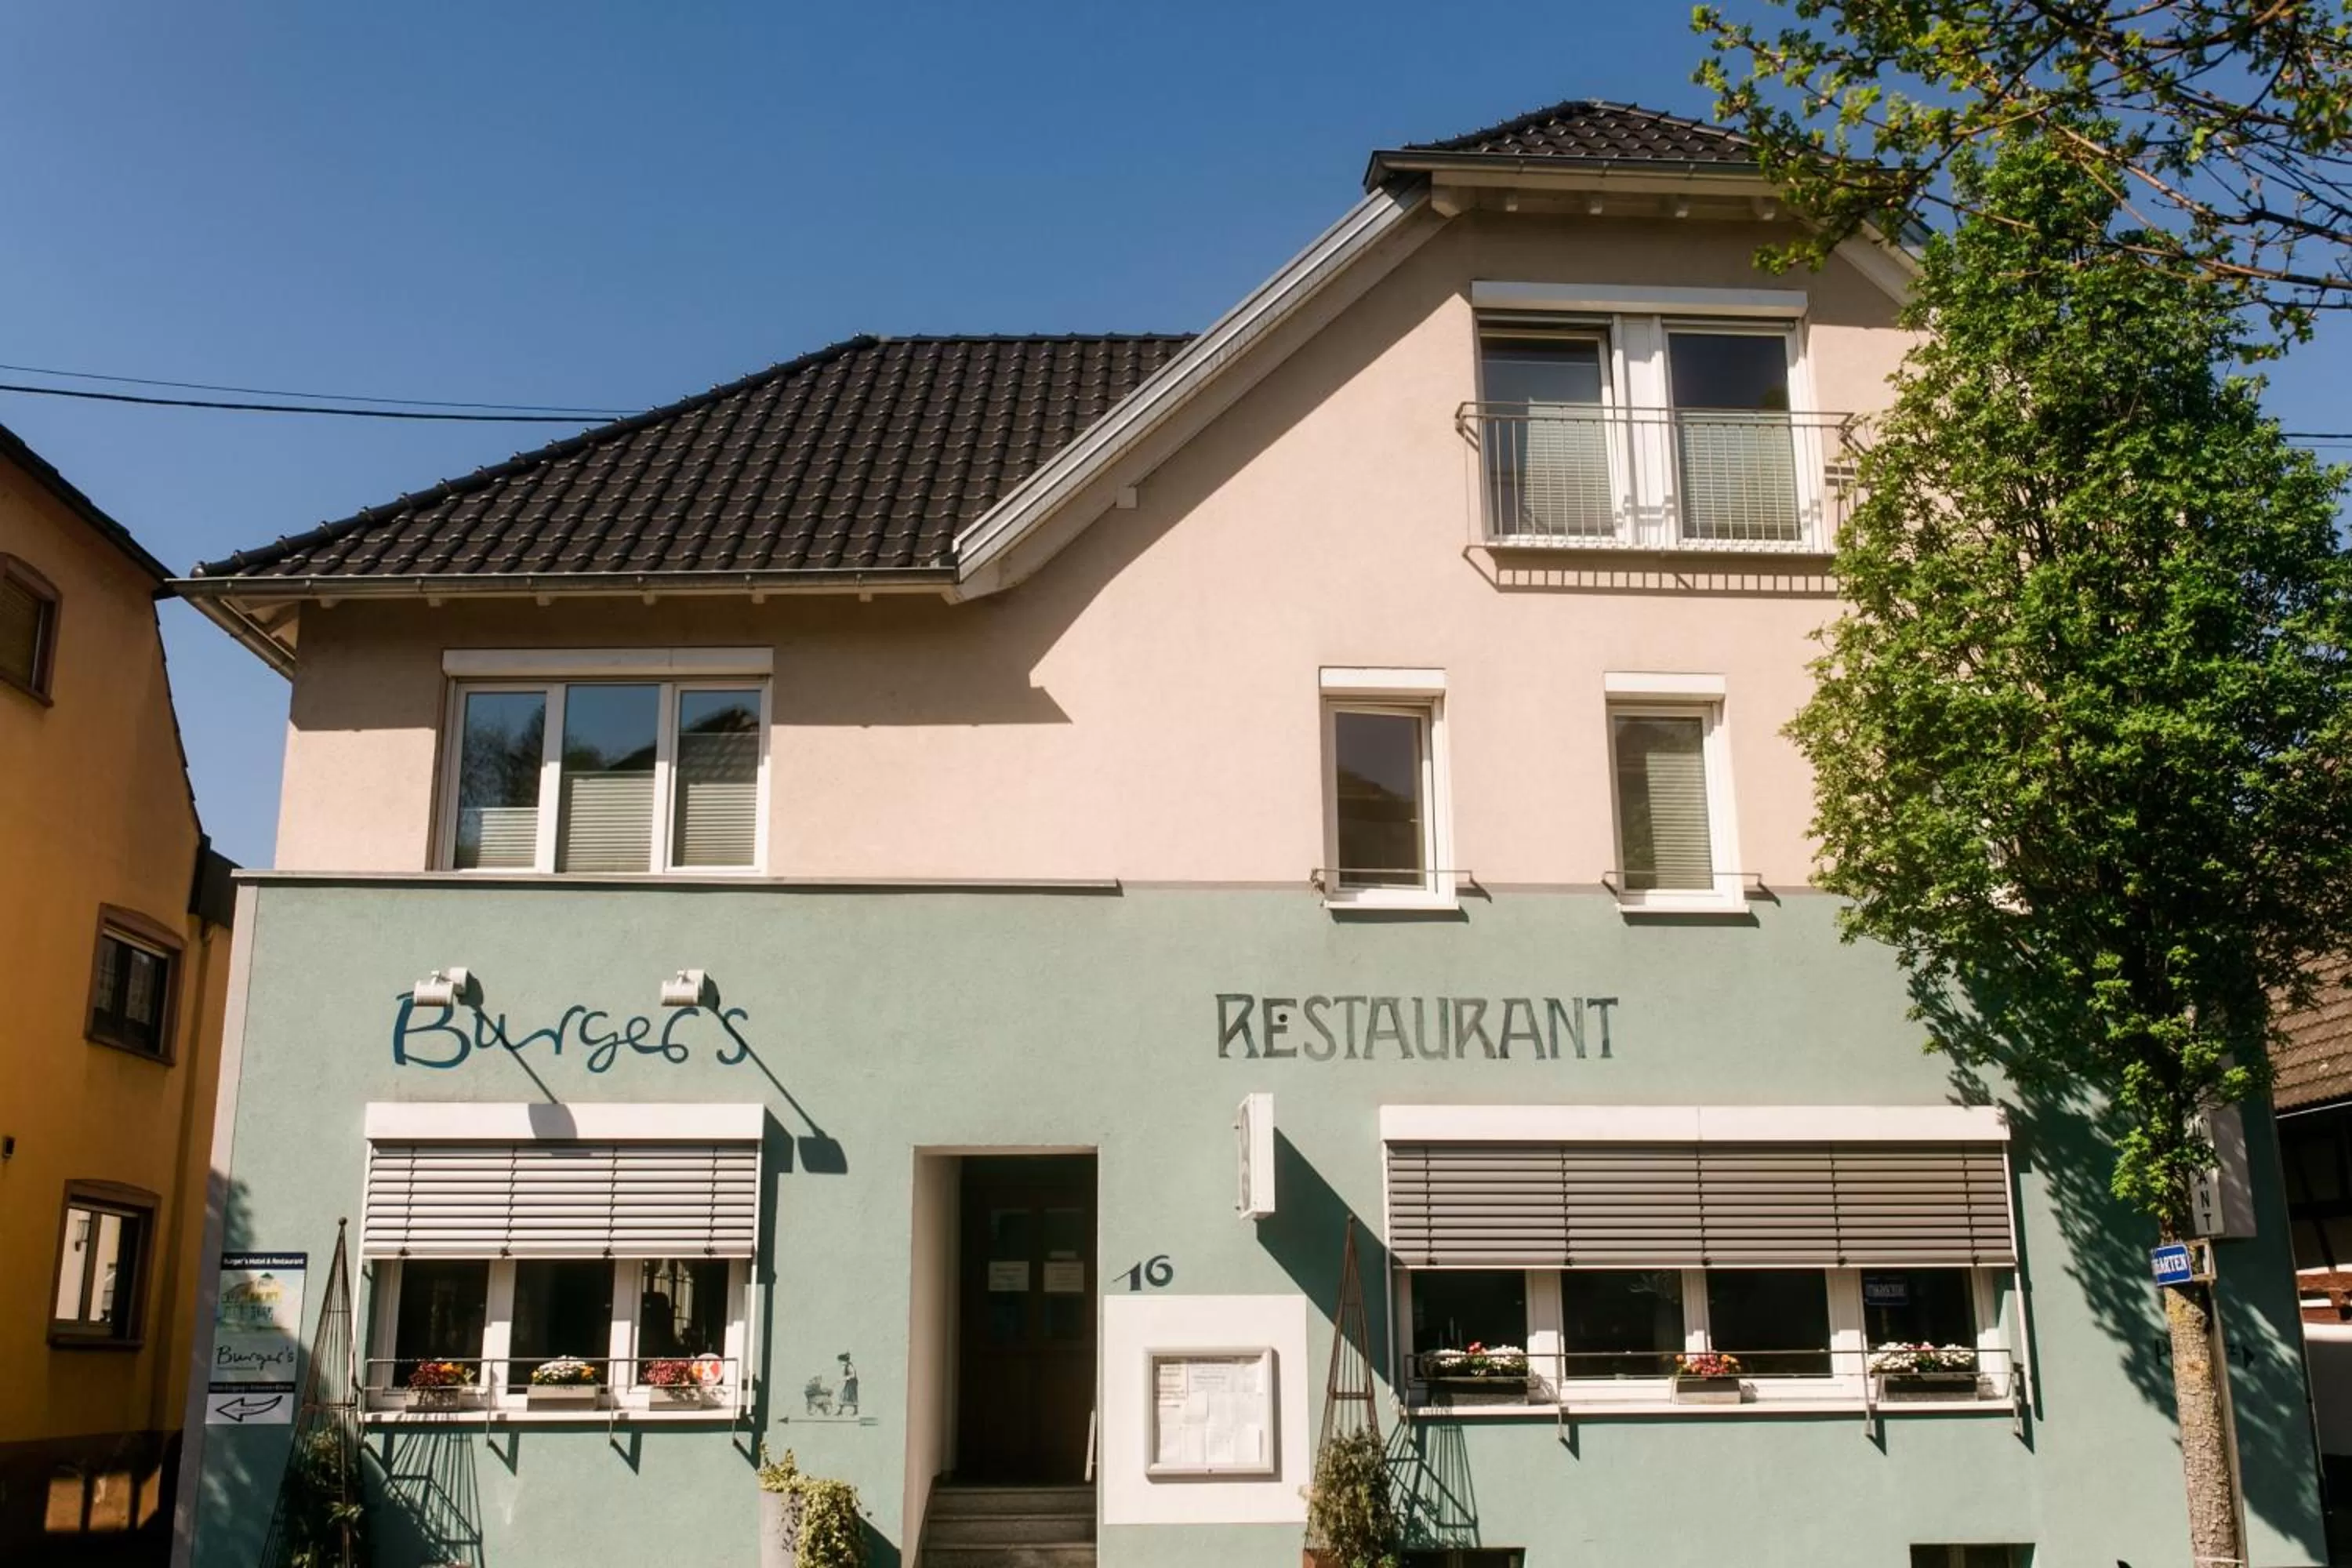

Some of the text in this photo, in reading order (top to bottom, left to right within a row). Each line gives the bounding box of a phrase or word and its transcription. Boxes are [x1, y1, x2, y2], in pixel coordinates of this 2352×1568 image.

[1216, 993, 1618, 1061] RESTAURANT
[1112, 1254, 1174, 1291] 16
[216, 1345, 294, 1370] Burger's
